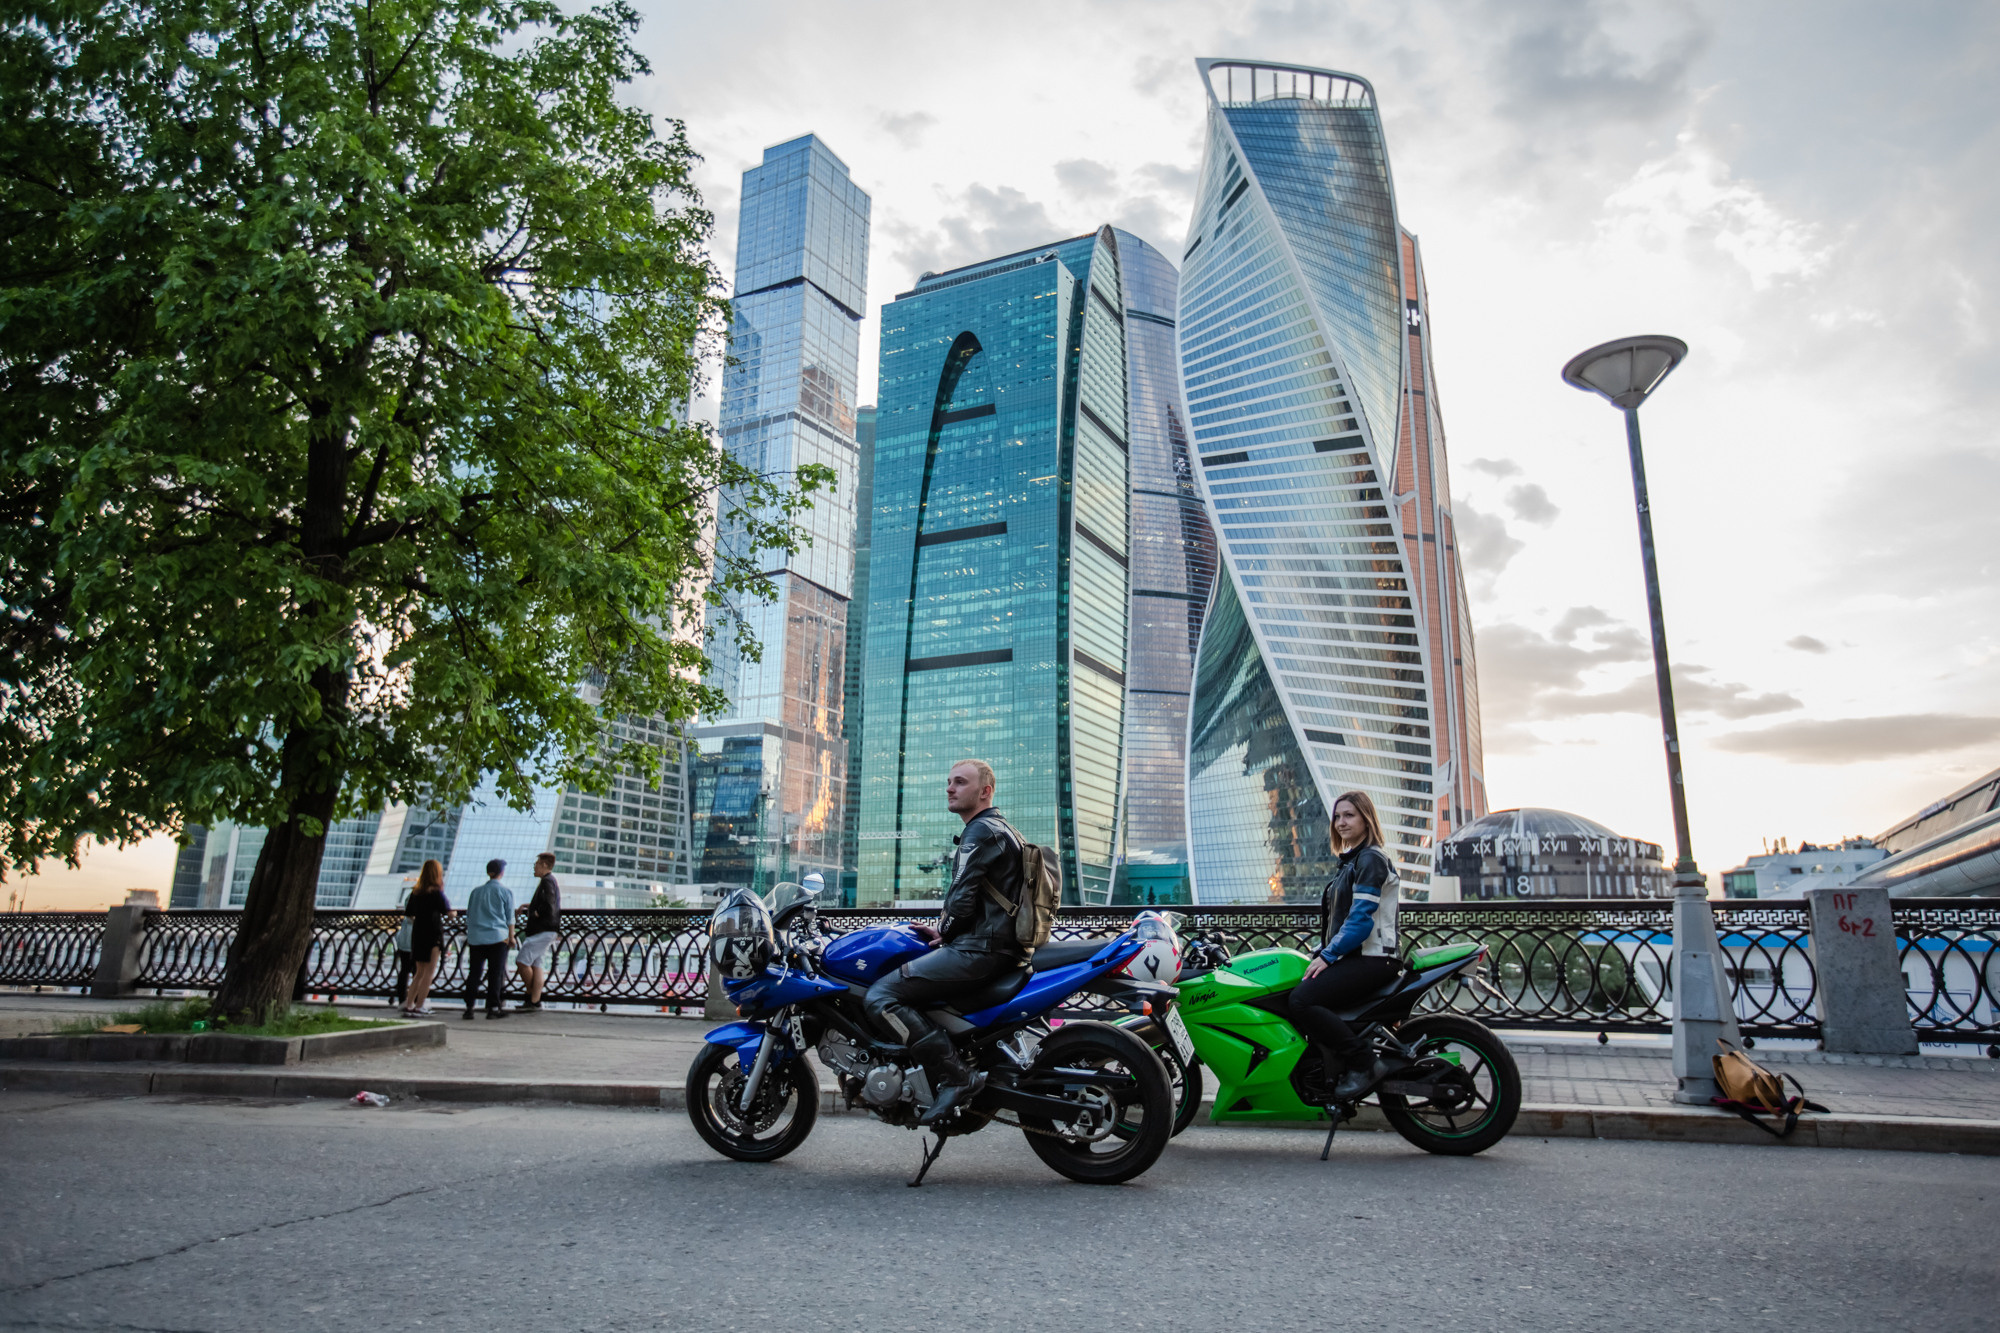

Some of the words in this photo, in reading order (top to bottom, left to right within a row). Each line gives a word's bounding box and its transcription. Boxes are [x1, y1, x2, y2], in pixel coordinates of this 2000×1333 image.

[1517, 875, 1531, 894] 8
[1243, 958, 1279, 975] Kawasaki
[1189, 989, 1219, 1006] Ninja
